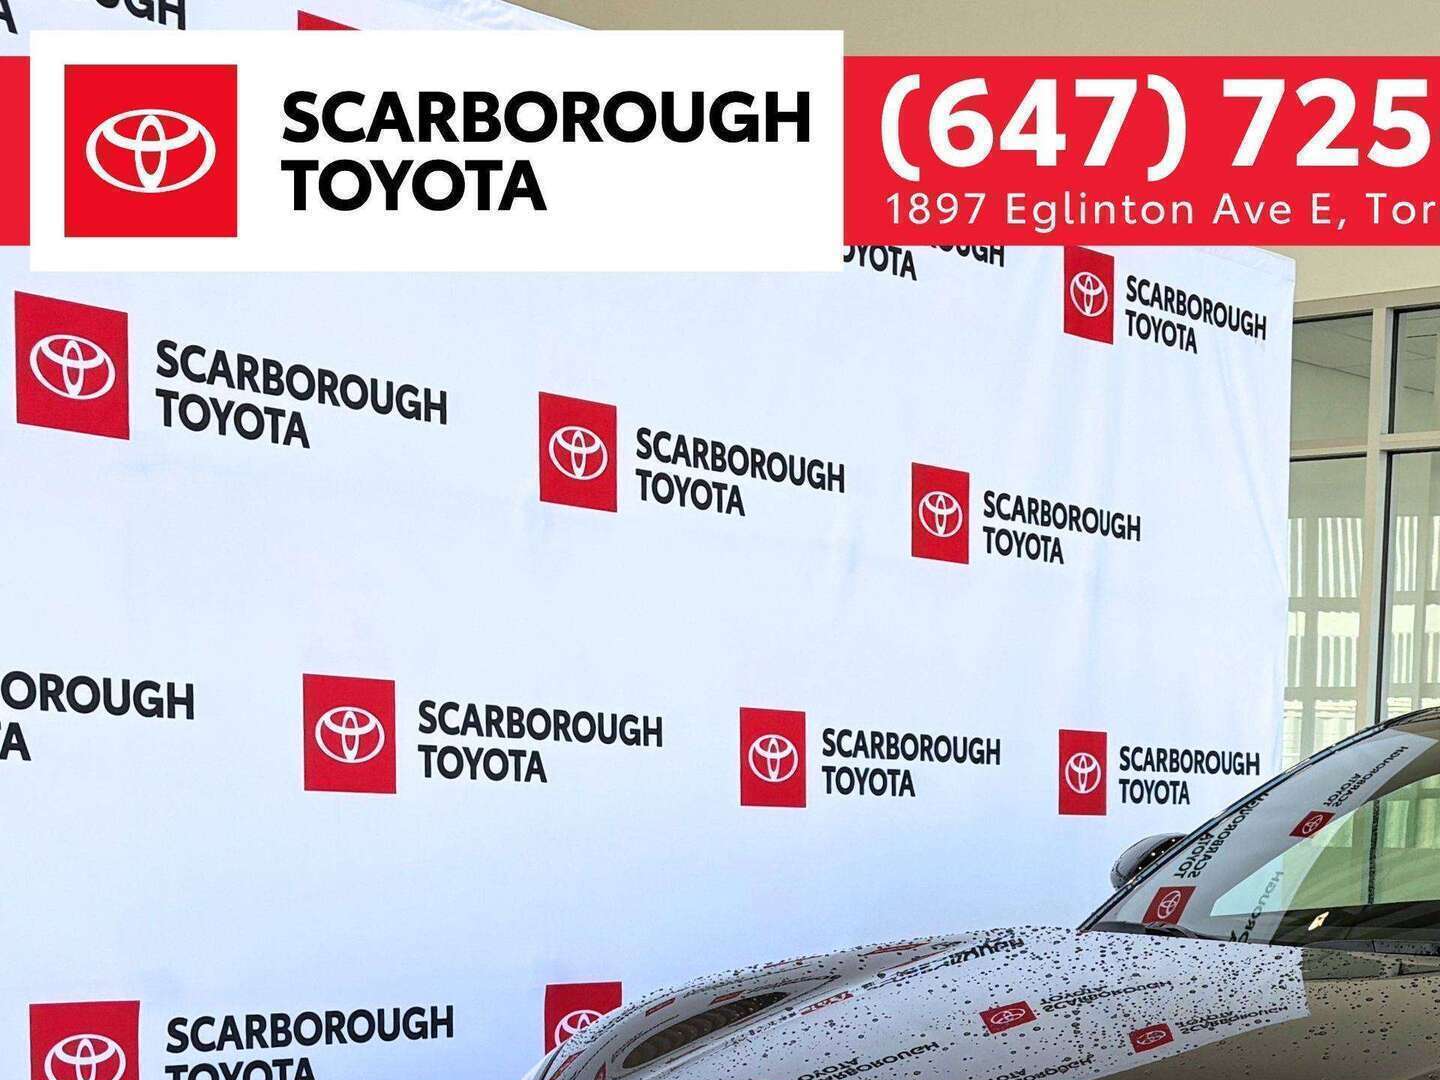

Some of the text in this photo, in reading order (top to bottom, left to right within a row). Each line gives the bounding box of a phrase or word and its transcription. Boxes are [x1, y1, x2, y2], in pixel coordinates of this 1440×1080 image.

[1127, 275, 1266, 340] SCARBOROUGH
[1126, 310, 1197, 353] TOYOTA
[157, 340, 446, 424] SCARBOROUGH
[156, 389, 310, 448] TOYOTA
[637, 428, 844, 493] SCARBOROUGH
[636, 469, 745, 516] TOYOTA
[984, 491, 1140, 541] SCARBOROUGH
[983, 526, 1063, 564] TOYOTA
[419, 700, 662, 747] SCARBOROUGH
[823, 728, 1001, 765] SCARBOROUGH
[418, 745, 547, 783] TOYOTA
[822, 766, 915, 797] TOYOTA
[1120, 746, 1260, 775] SCARBOROUGH
[1119, 779, 1189, 804] TOYOTA
[167, 1005, 453, 1053] SCARBOROUGH
